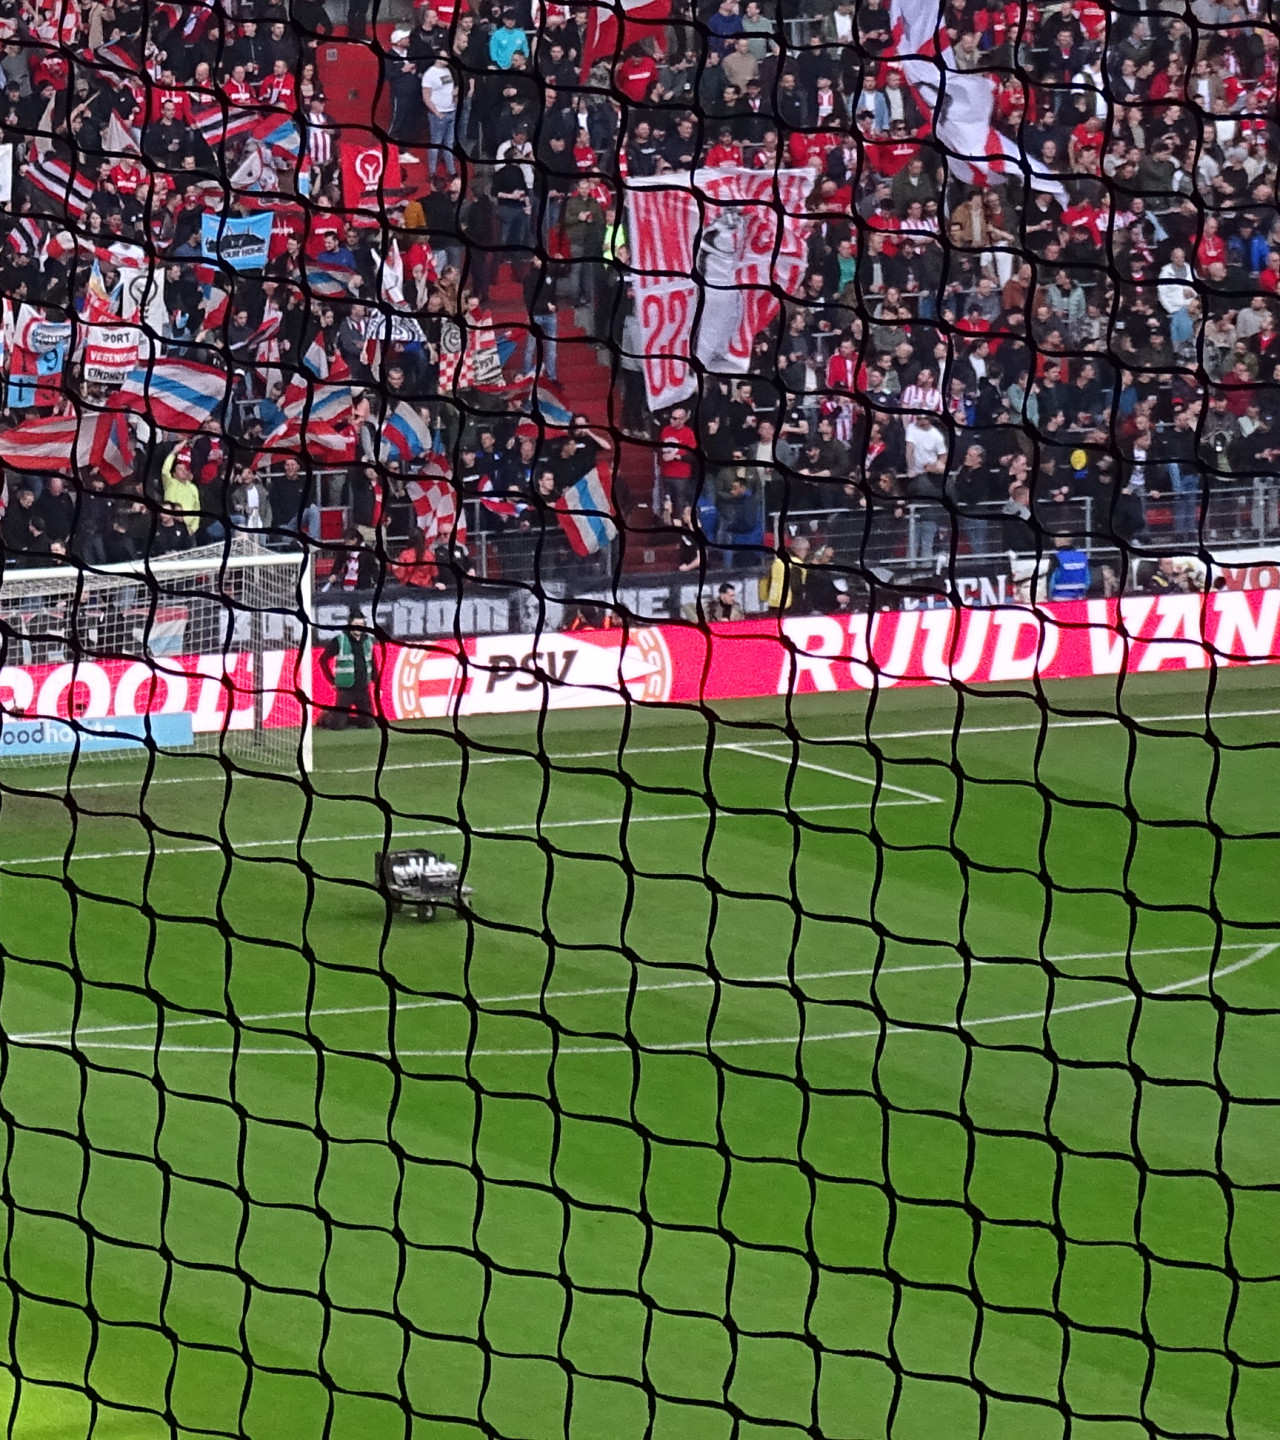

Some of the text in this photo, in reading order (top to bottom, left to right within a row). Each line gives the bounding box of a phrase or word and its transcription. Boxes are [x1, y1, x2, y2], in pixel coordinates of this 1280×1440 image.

[486, 649, 579, 693] PSV
[777, 601, 1060, 694] RUUD
[1087, 589, 1280, 674] VAN
